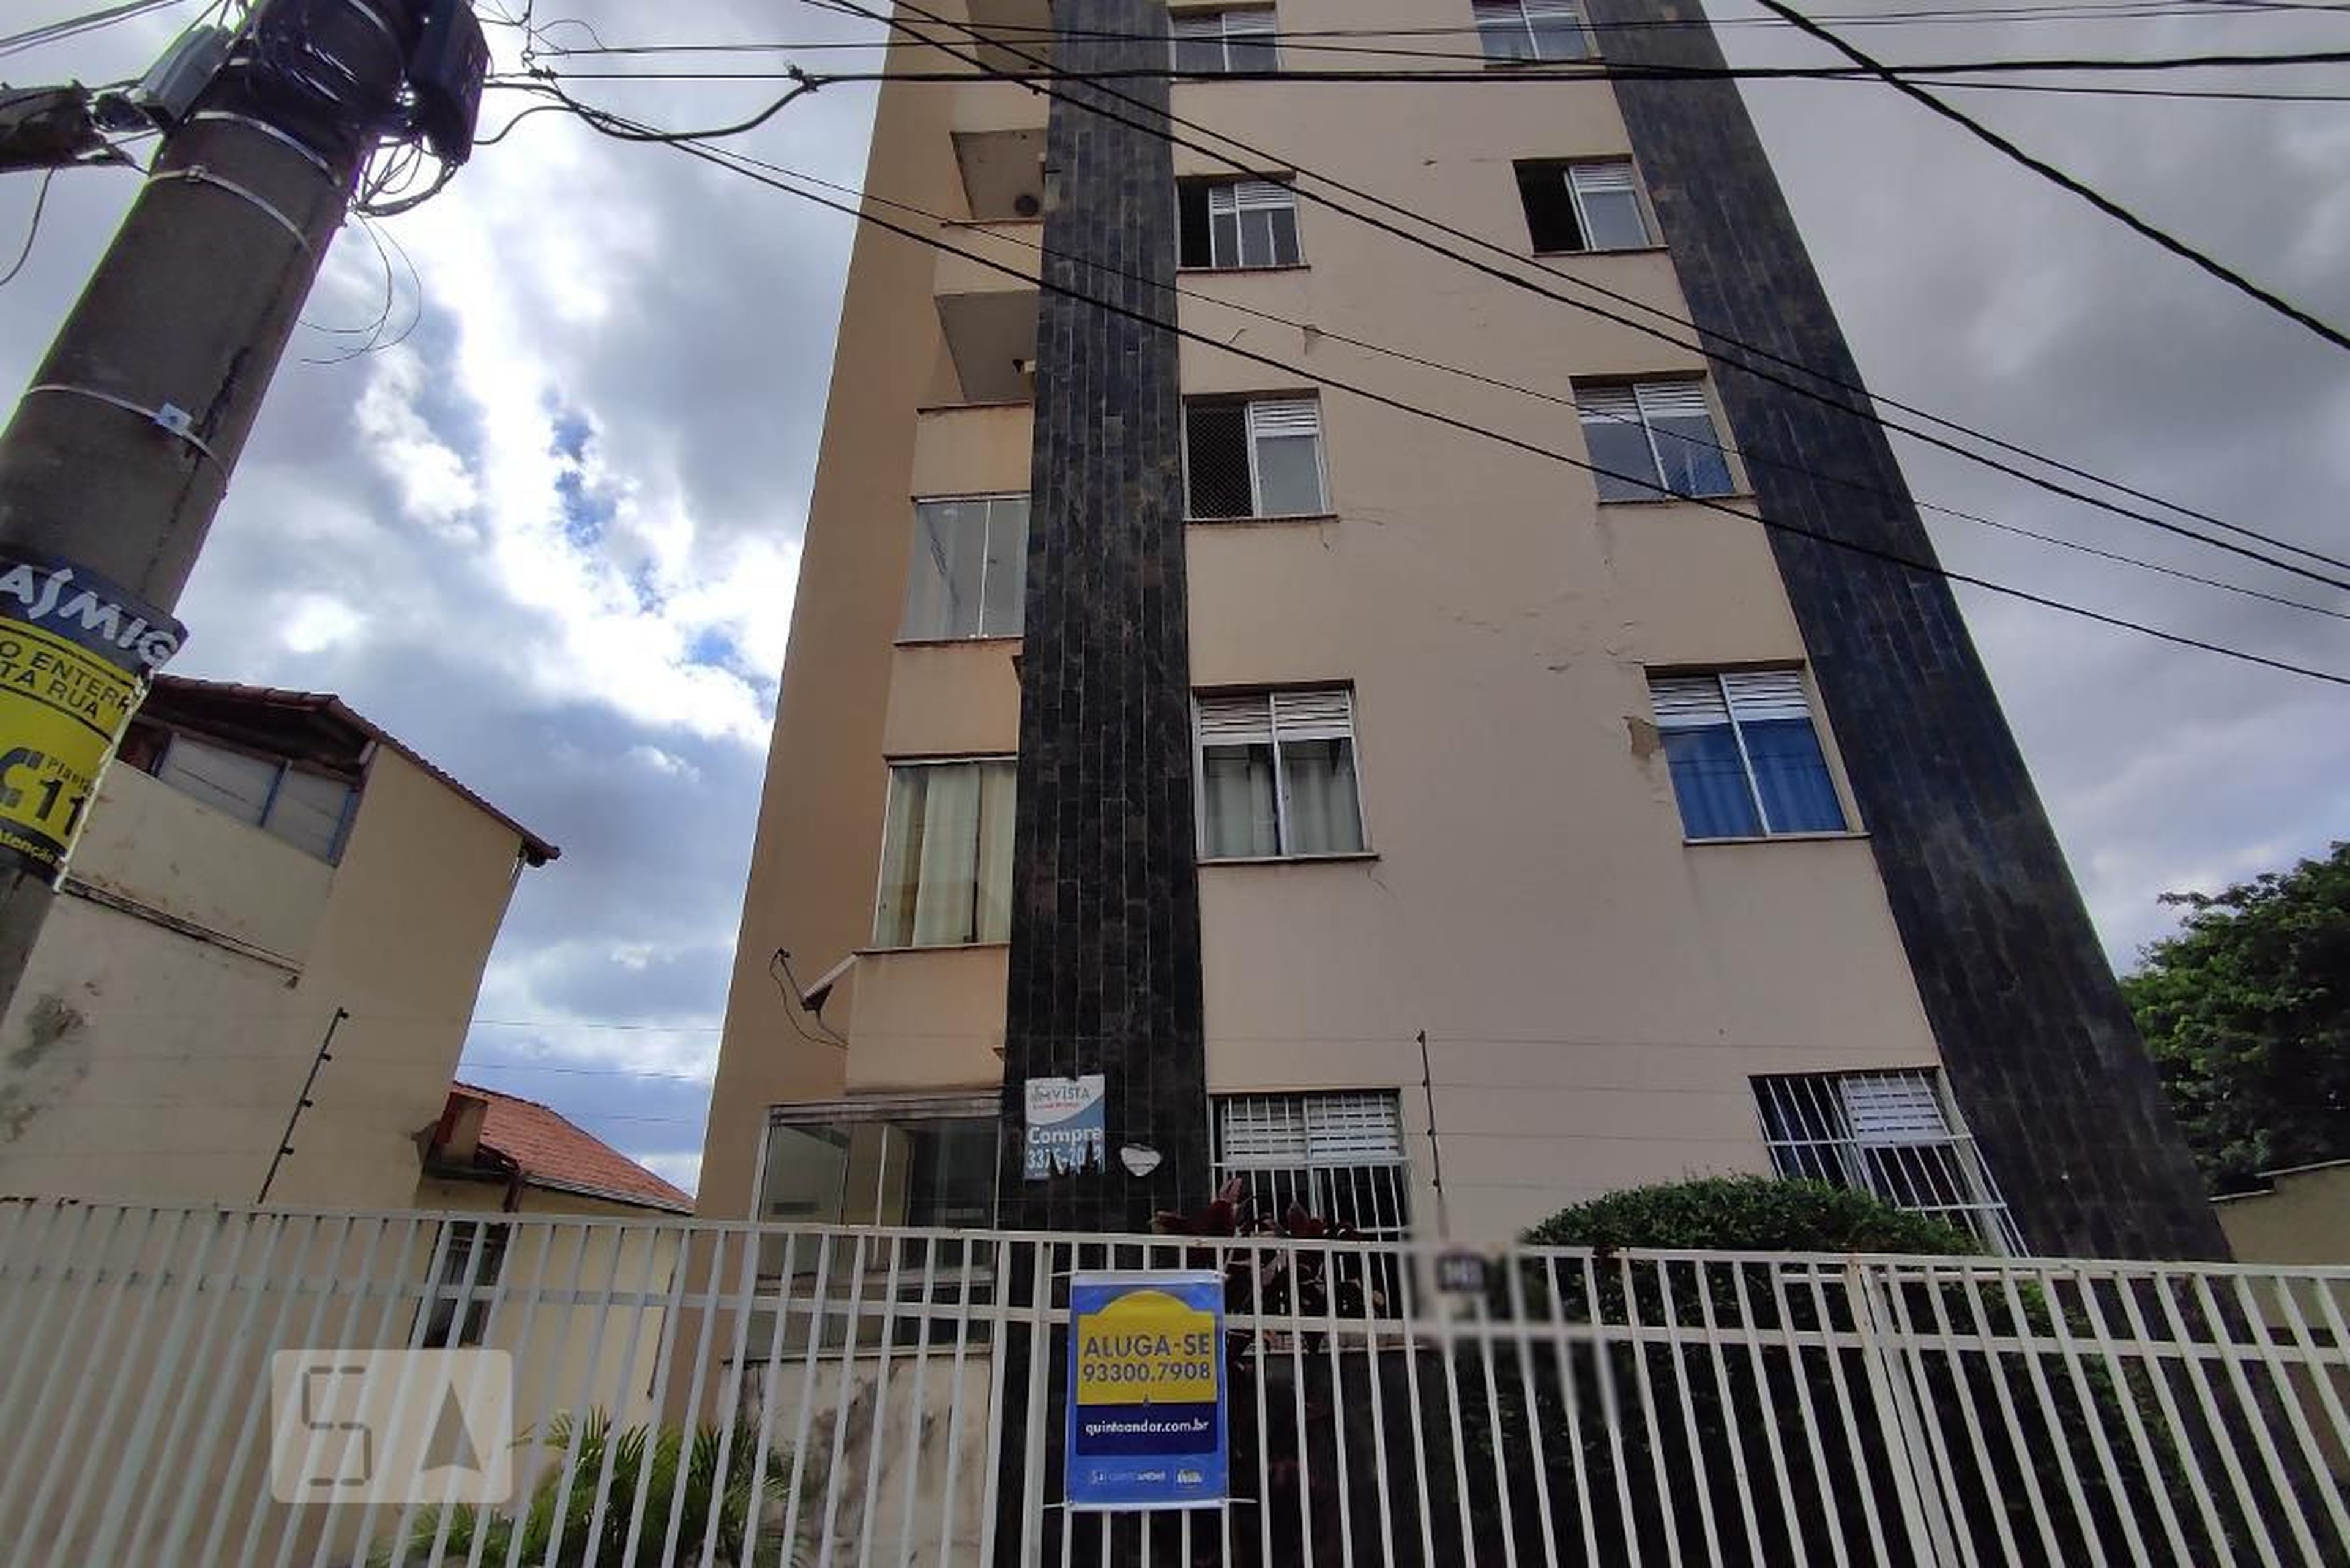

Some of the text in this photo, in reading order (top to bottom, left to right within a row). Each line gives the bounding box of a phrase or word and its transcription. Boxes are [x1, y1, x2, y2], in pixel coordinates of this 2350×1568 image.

[47, 679, 99, 719] RUA
[1028, 1127, 1102, 1146] Compra
[1084, 1333, 1209, 1358] ALUGA-SE
[1083, 1362, 1210, 1382] 93300.7908
